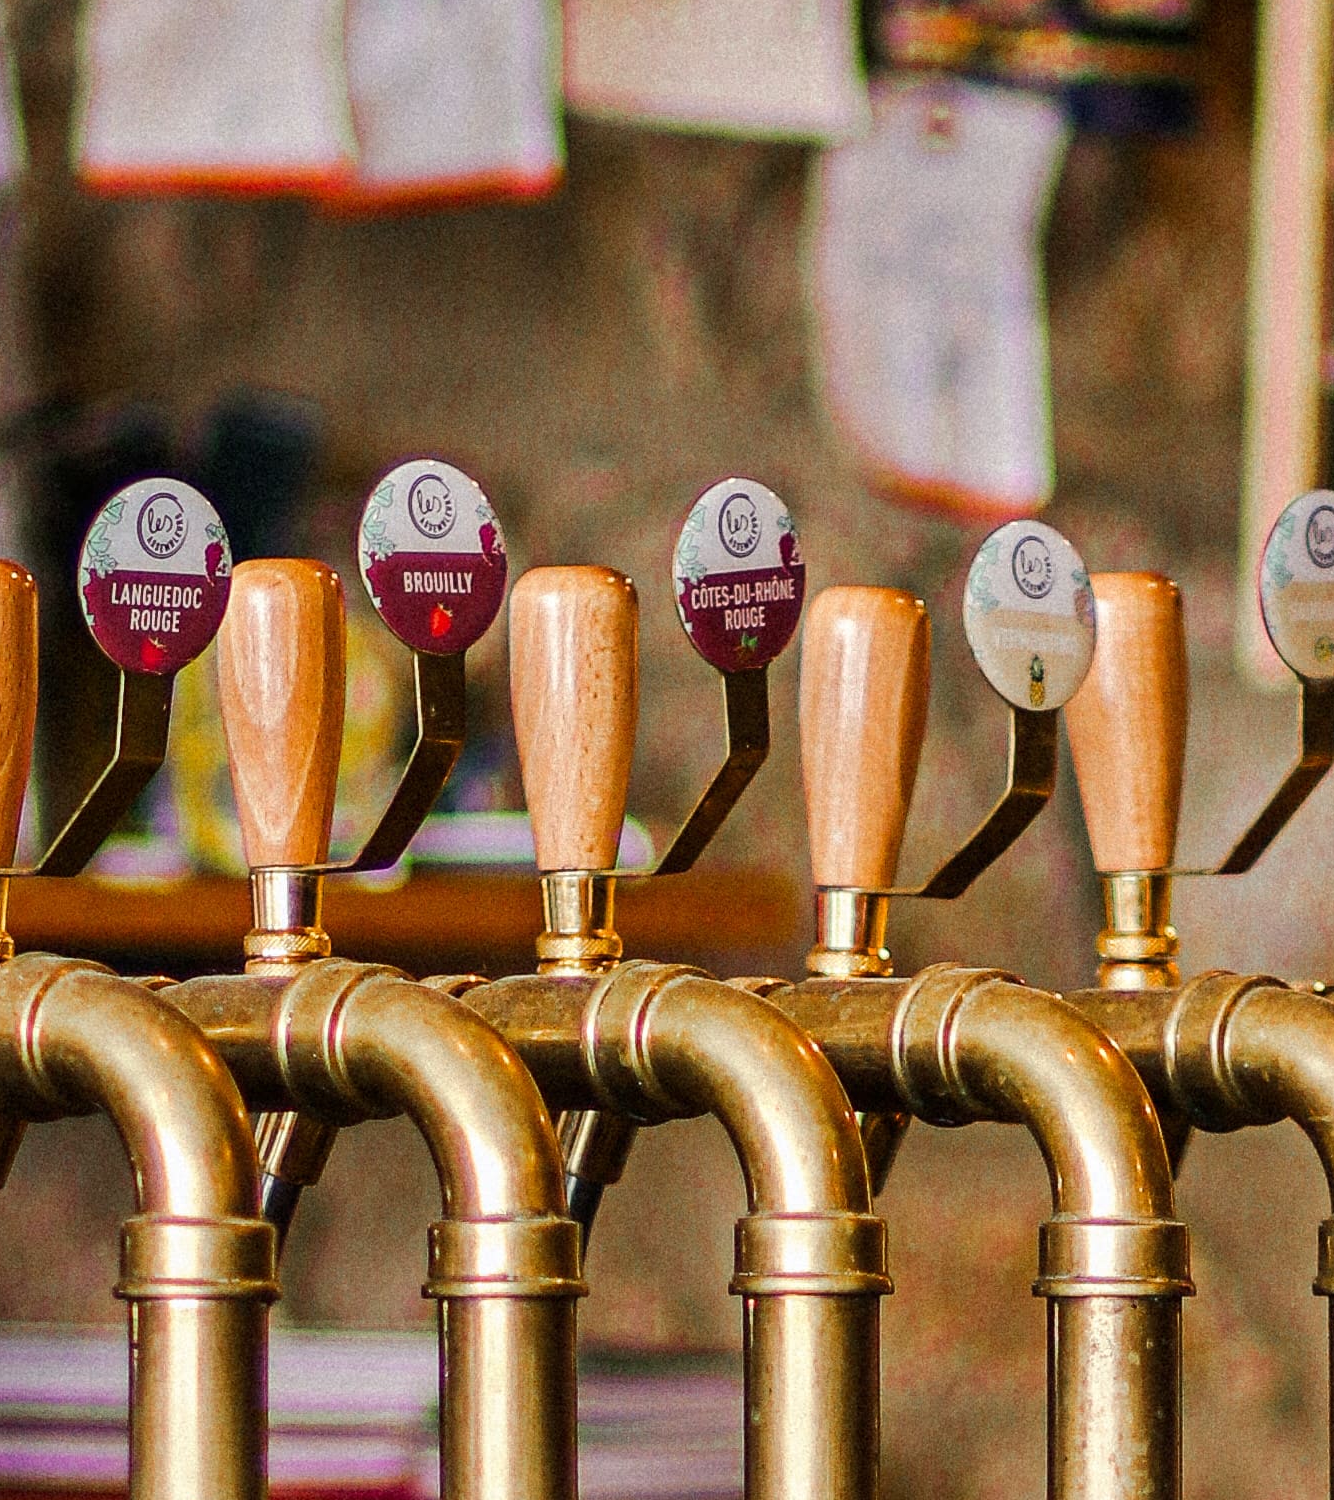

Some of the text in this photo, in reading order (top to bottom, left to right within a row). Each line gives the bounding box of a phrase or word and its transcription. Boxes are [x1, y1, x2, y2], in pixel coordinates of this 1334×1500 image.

[416, 489, 442, 515] les
[147, 507, 174, 534] les
[725, 509, 750, 535] les
[111, 582, 203, 609] LANGUEDOC
[403, 571, 473, 594] BROUILLY
[691, 575, 796, 610] CÔTES-DU-RHÔNE
[130, 609, 181, 633] ROUGE
[725, 606, 766, 631] ROUGE
